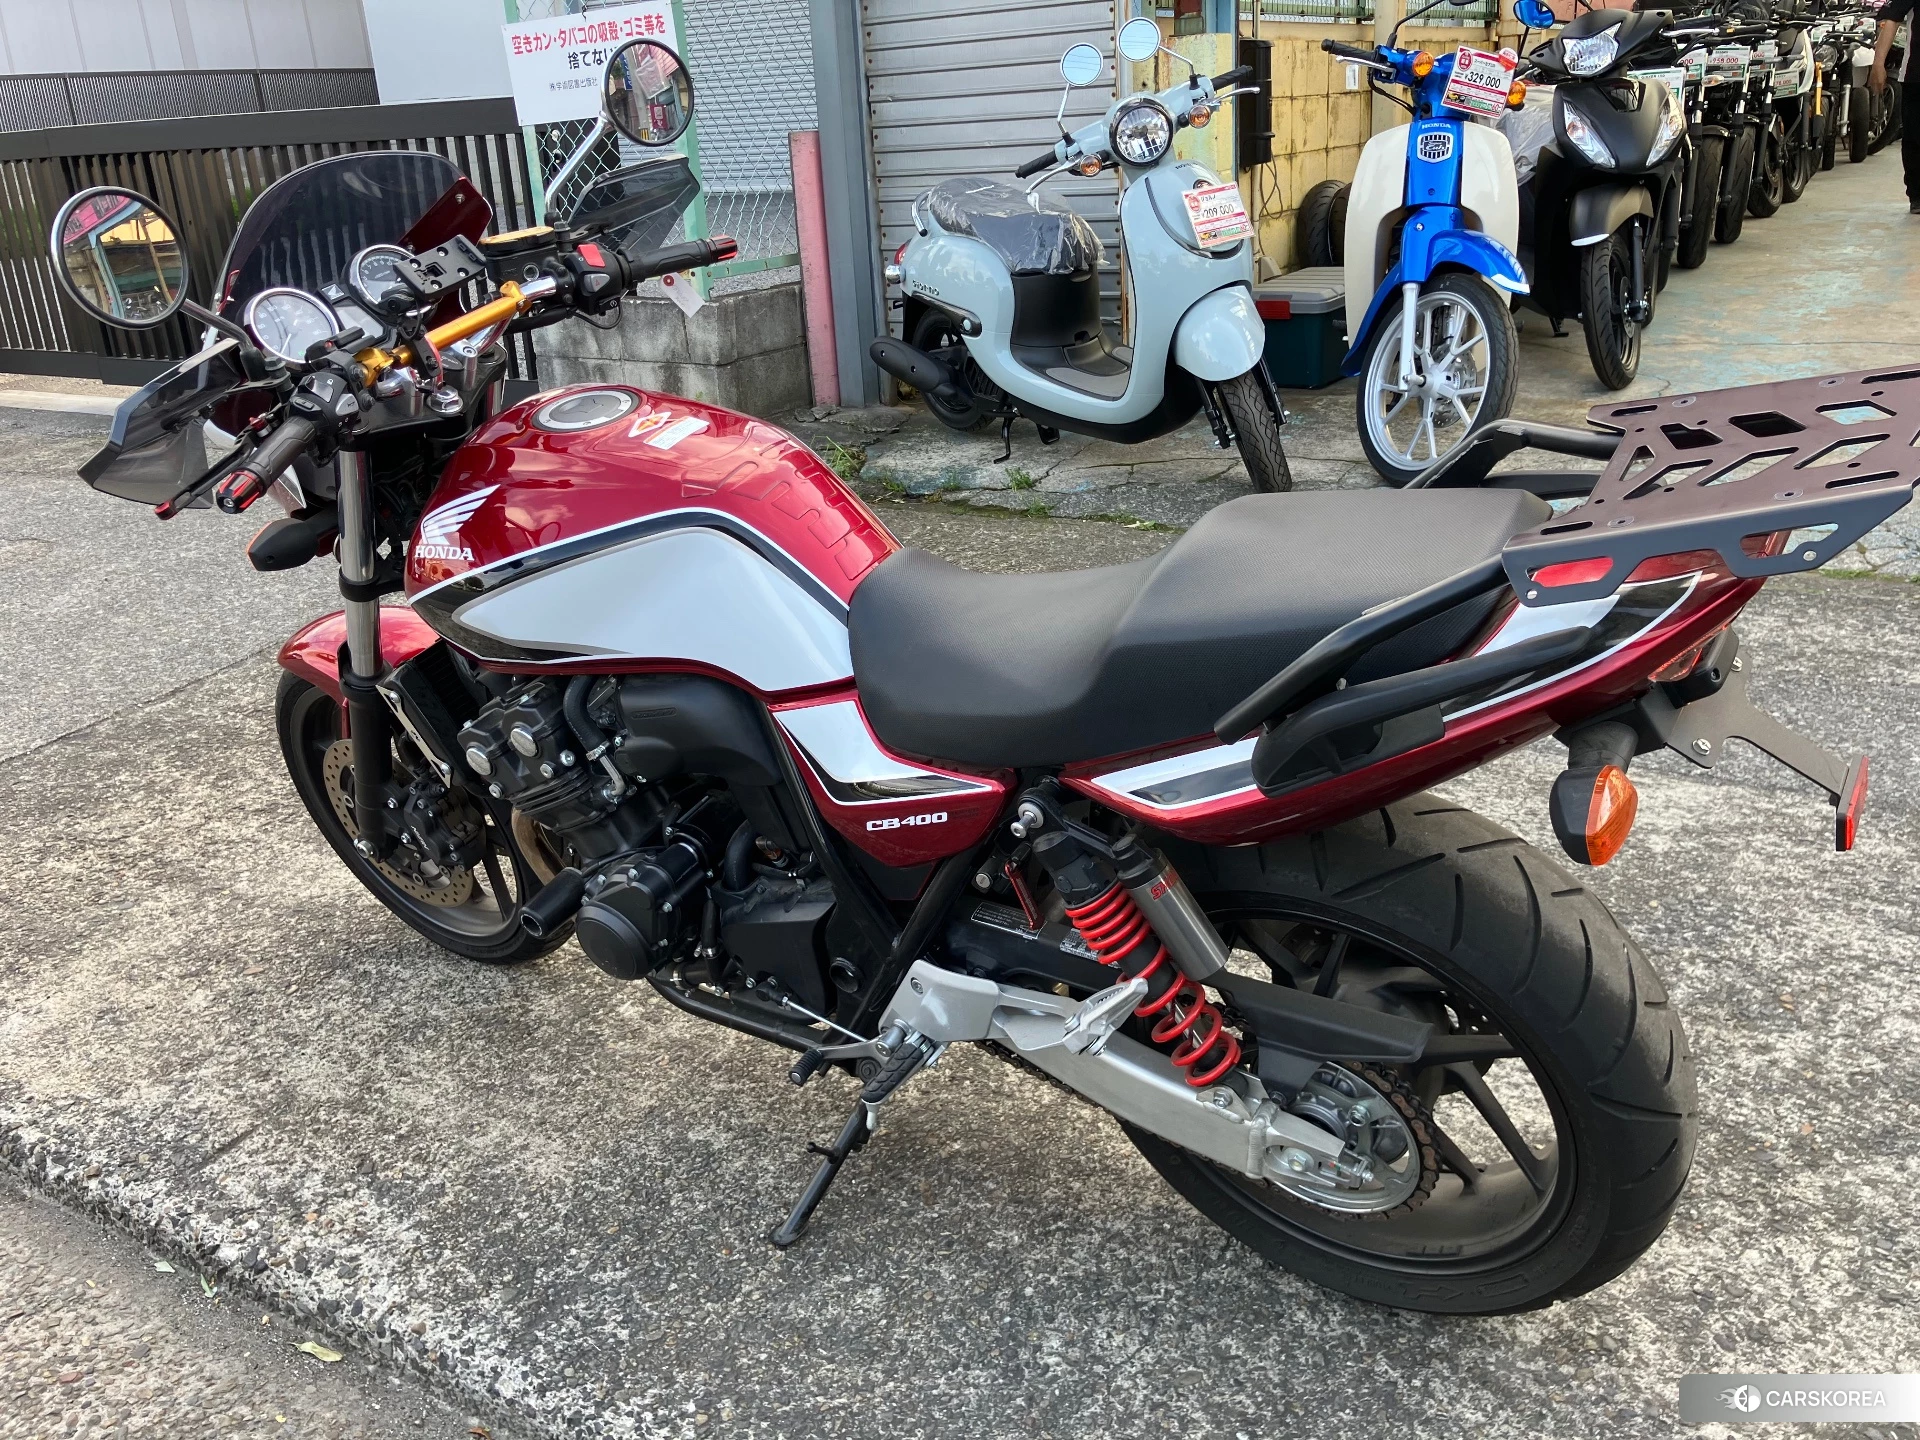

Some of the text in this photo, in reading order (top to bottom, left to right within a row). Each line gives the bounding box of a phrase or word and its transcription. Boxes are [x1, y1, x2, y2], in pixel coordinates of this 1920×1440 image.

[511, 13, 666, 55] 空きカン・タバコの吸殻・ゴミ等を
[1421, 122, 1451, 130] HONDA
[414, 545, 475, 561] HONDA
[866, 811, 948, 831] CB400
